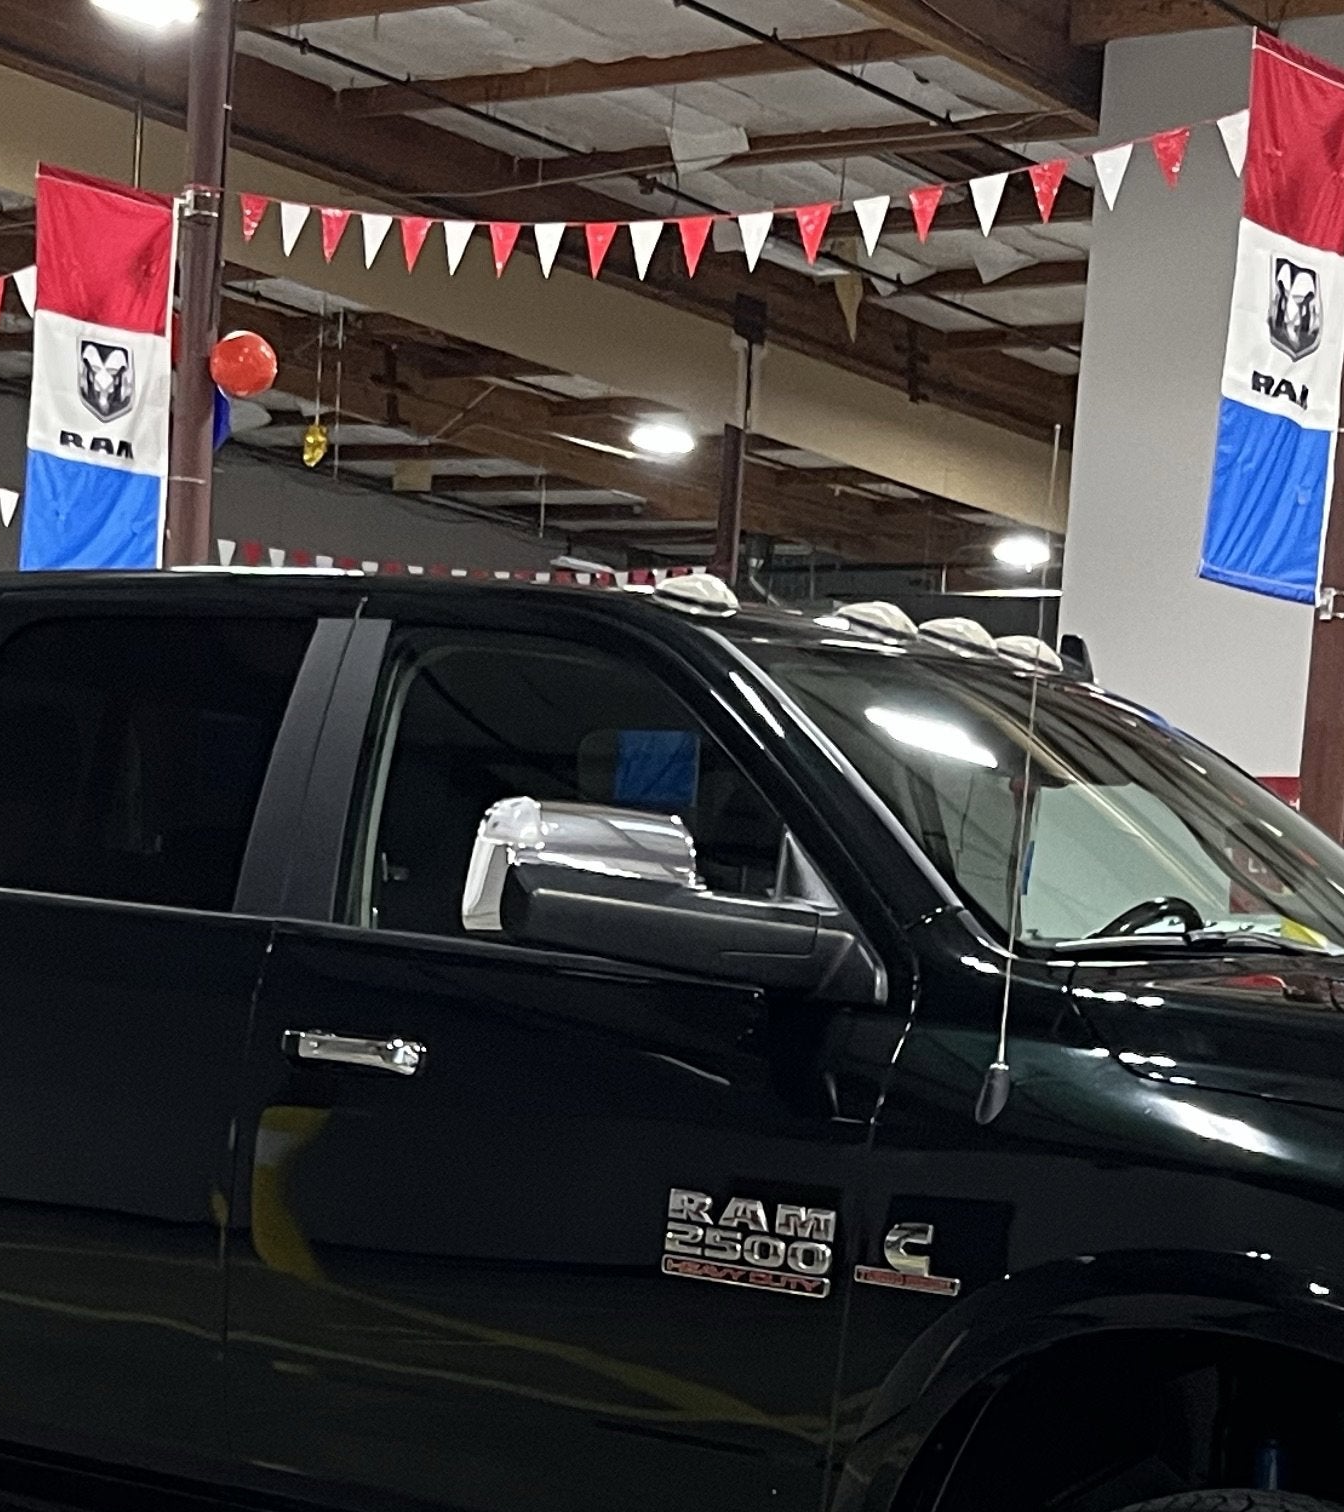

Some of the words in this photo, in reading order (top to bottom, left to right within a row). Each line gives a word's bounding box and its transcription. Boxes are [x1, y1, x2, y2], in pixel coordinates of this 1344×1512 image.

[668, 1188, 836, 1242] RAM
[665, 1221, 832, 1274] 2500
[666, 1258, 746, 1281] HEAVY
[748, 1271, 822, 1293] DUTY
